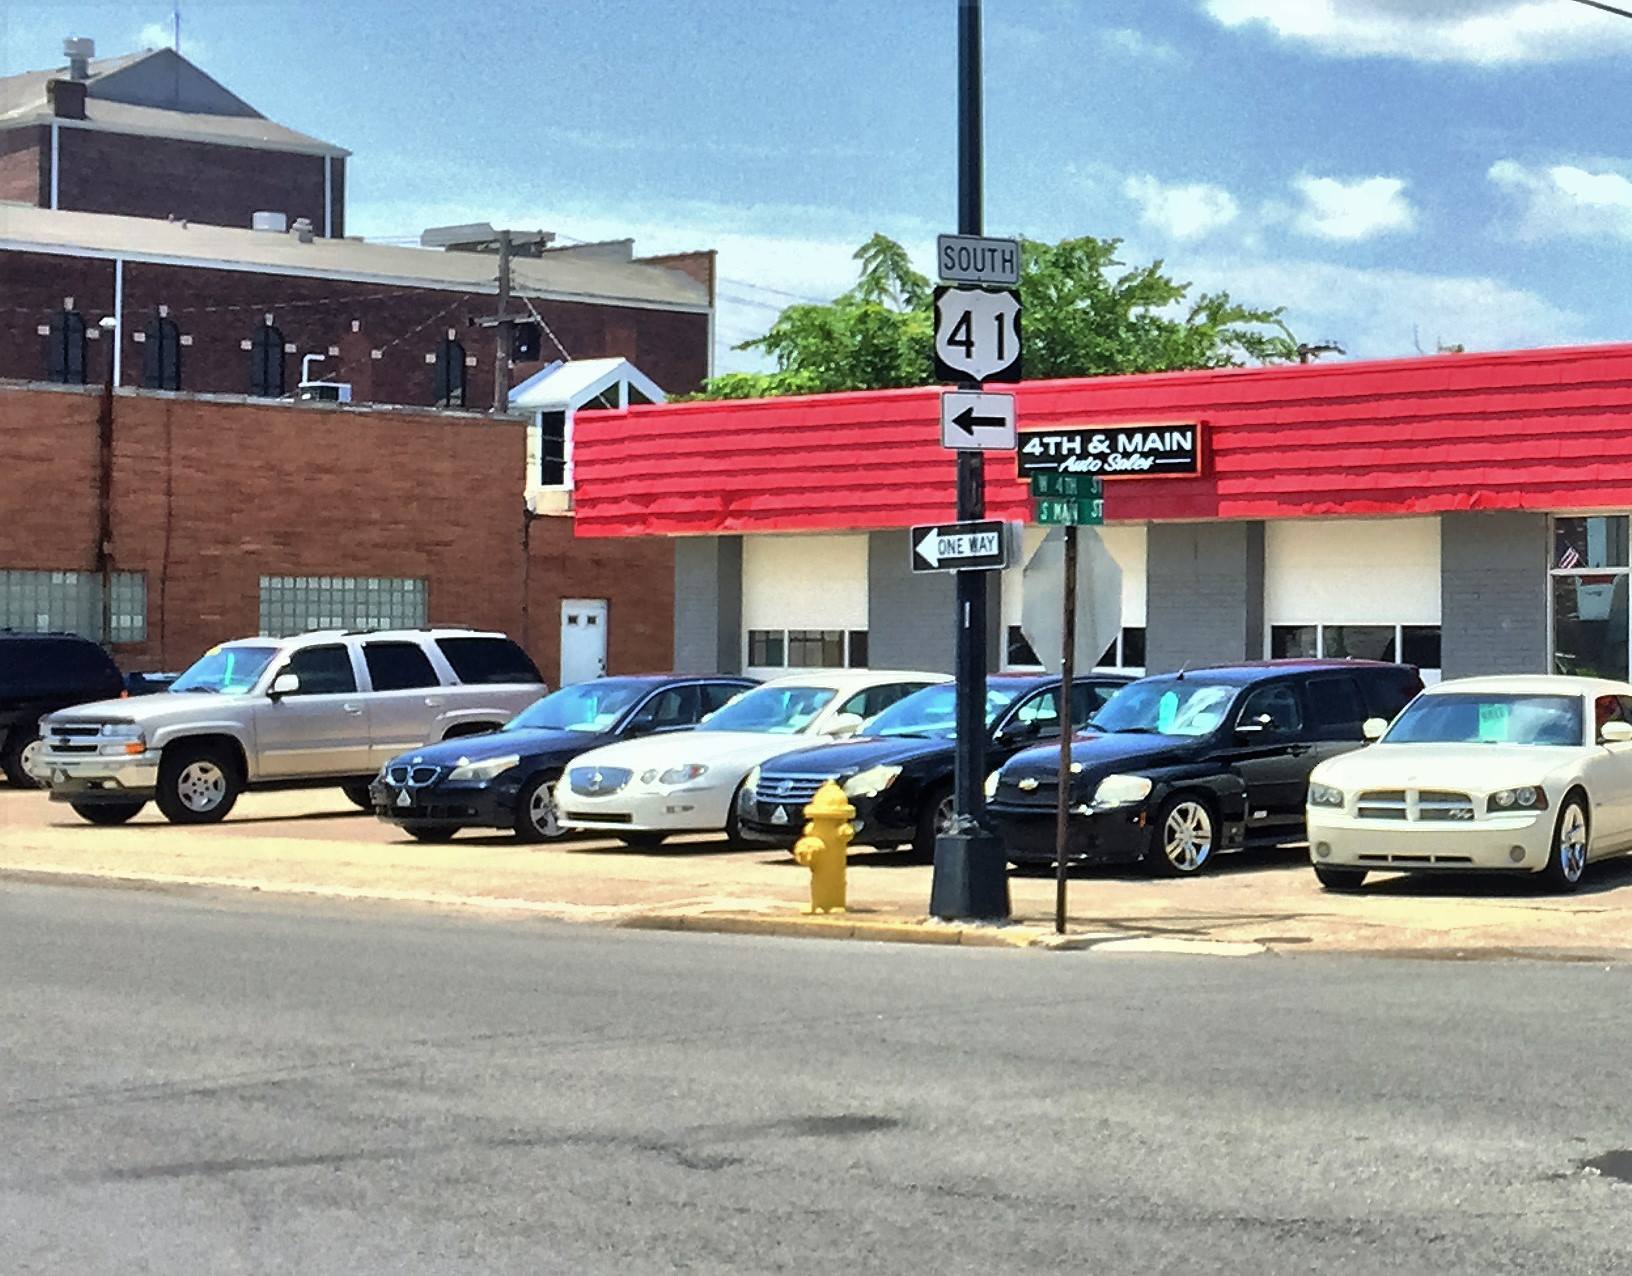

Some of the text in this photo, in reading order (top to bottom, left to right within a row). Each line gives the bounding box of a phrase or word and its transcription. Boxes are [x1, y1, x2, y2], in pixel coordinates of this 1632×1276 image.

[944, 245, 1014, 274] SOUTH
[946, 310, 1005, 361] 41
[1022, 431, 1192, 456] 4TH & MAIN
[1058, 453, 1154, 472] Auto Sales
[1040, 501, 1049, 520] S
[1090, 499, 1104, 518] ST
[937, 535, 995, 556] ONE WAY
